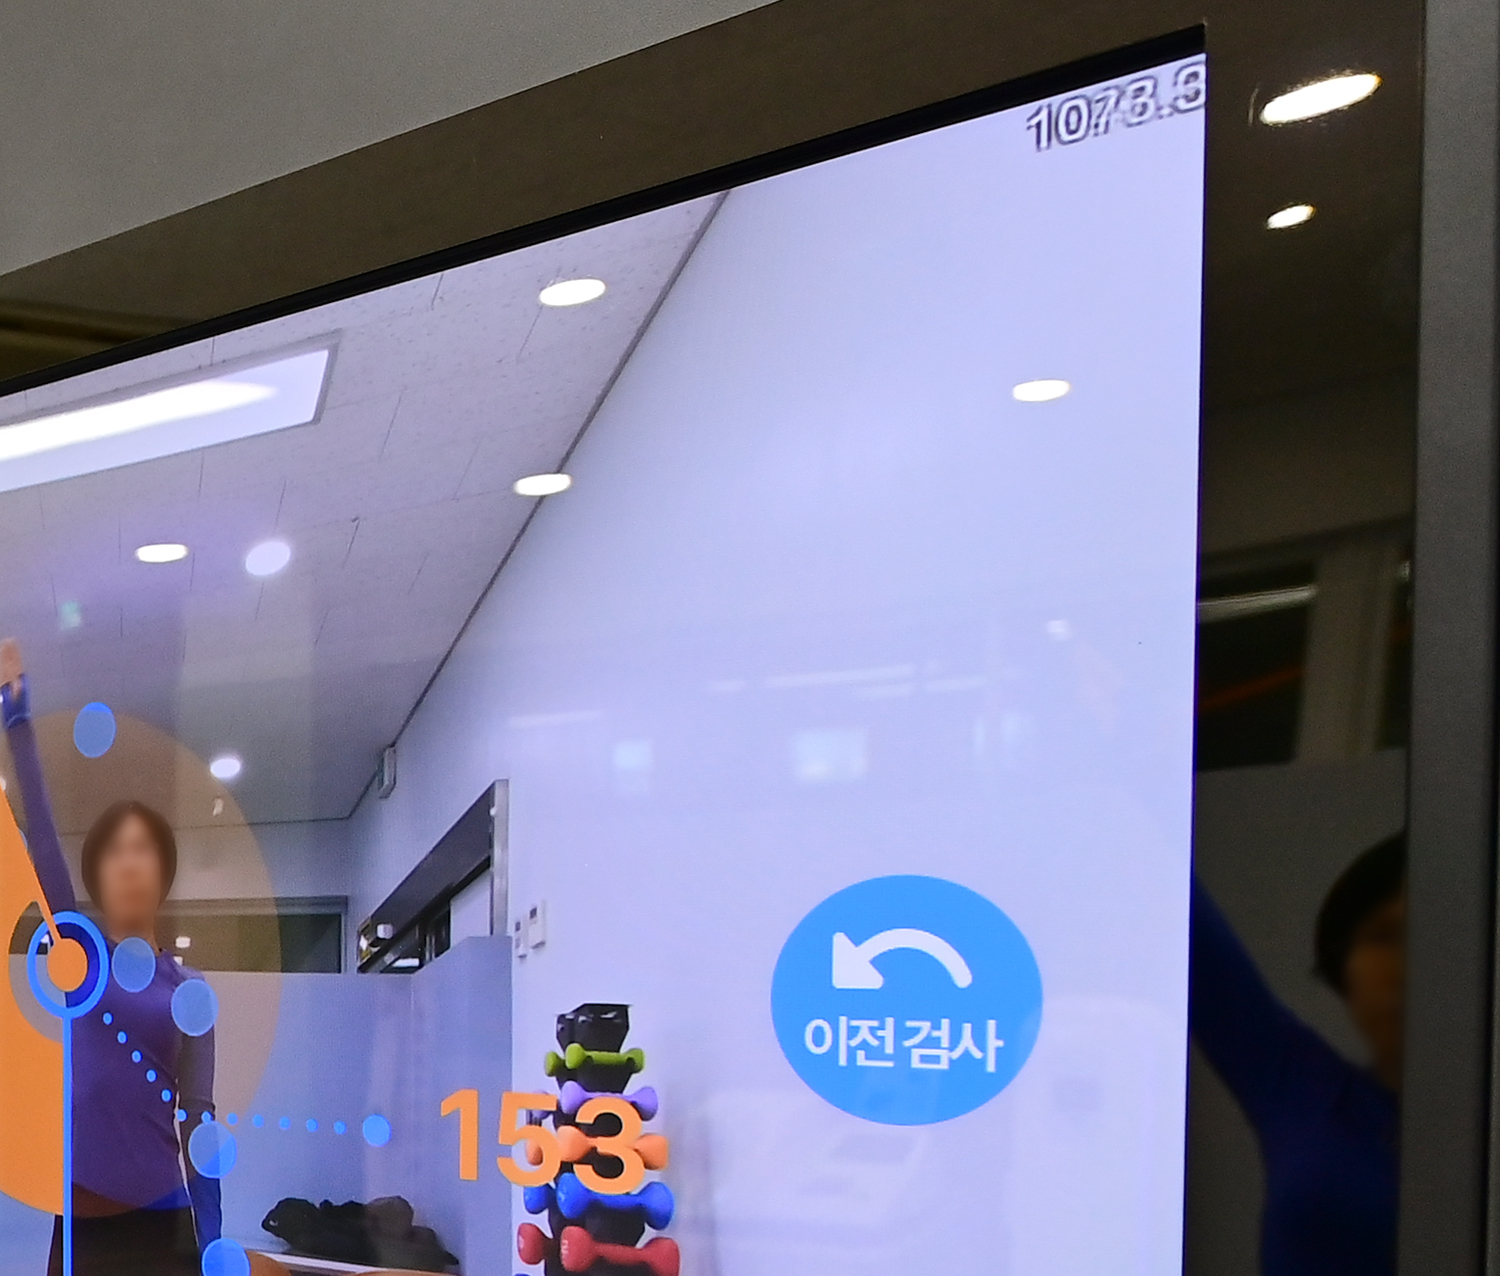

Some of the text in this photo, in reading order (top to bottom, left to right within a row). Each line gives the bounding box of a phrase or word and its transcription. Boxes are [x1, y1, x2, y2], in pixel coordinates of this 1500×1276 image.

[804, 1015, 1005, 1073] 이전 검사
[440, 1088, 646, 1195] 153
